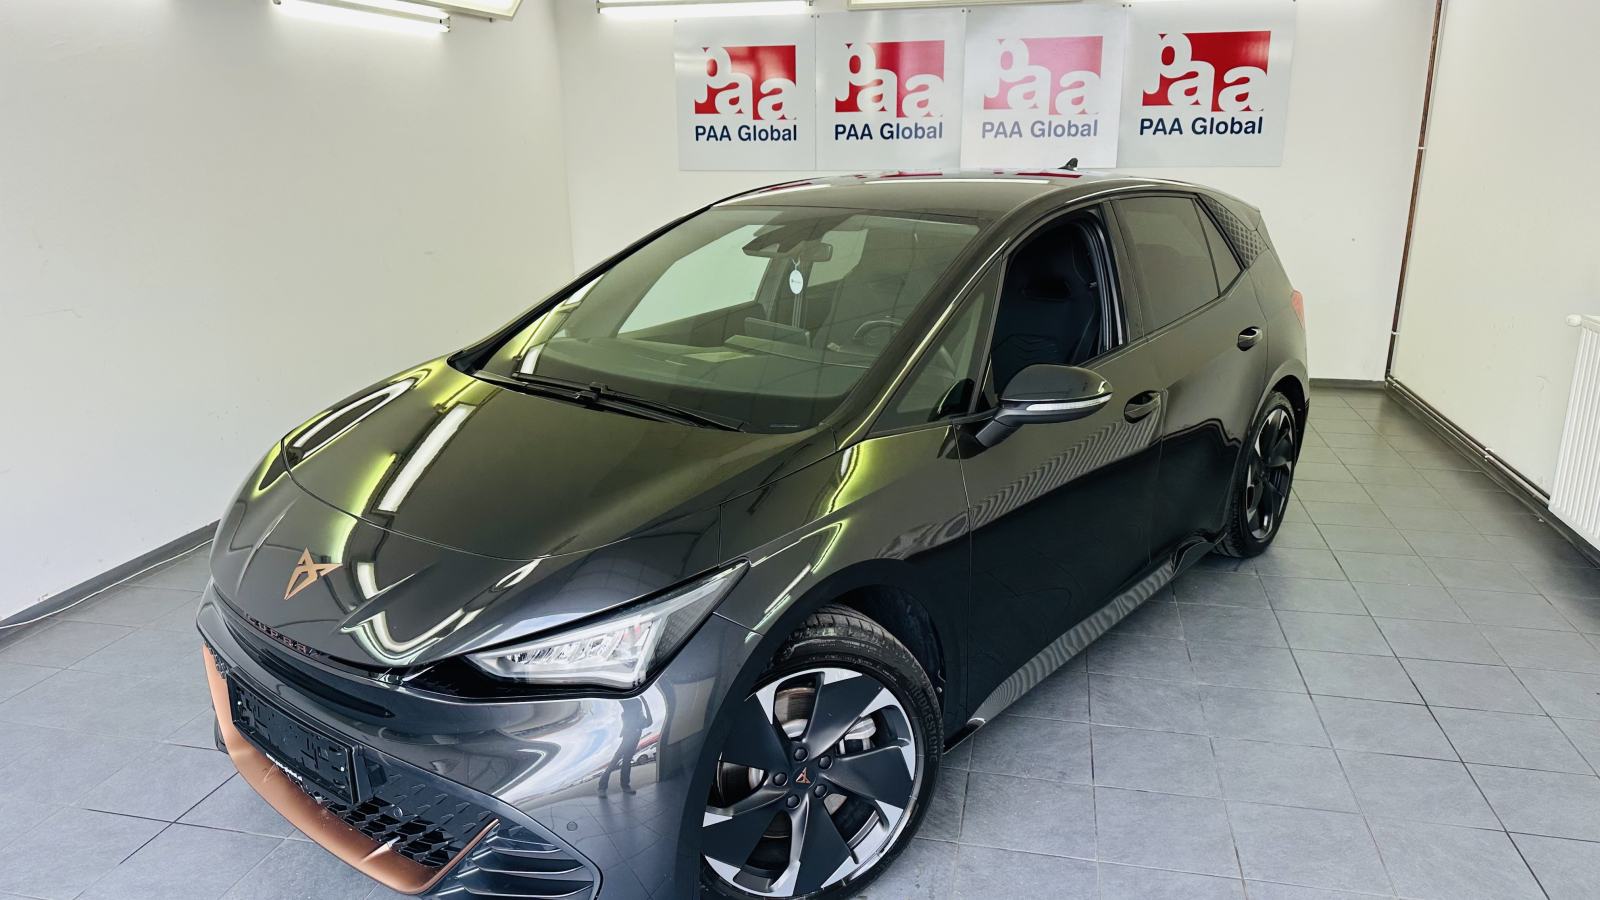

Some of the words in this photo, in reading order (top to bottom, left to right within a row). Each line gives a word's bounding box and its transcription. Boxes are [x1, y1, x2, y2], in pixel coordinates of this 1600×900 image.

[695, 125, 732, 142] PAA
[738, 124, 797, 141] Global
[835, 123, 873, 140] PAA
[880, 122, 943, 140] Global
[982, 121, 1023, 139] PAA
[1030, 119, 1098, 138] Global
[1140, 117, 1183, 135] PAA
[1191, 116, 1263, 135] Global
